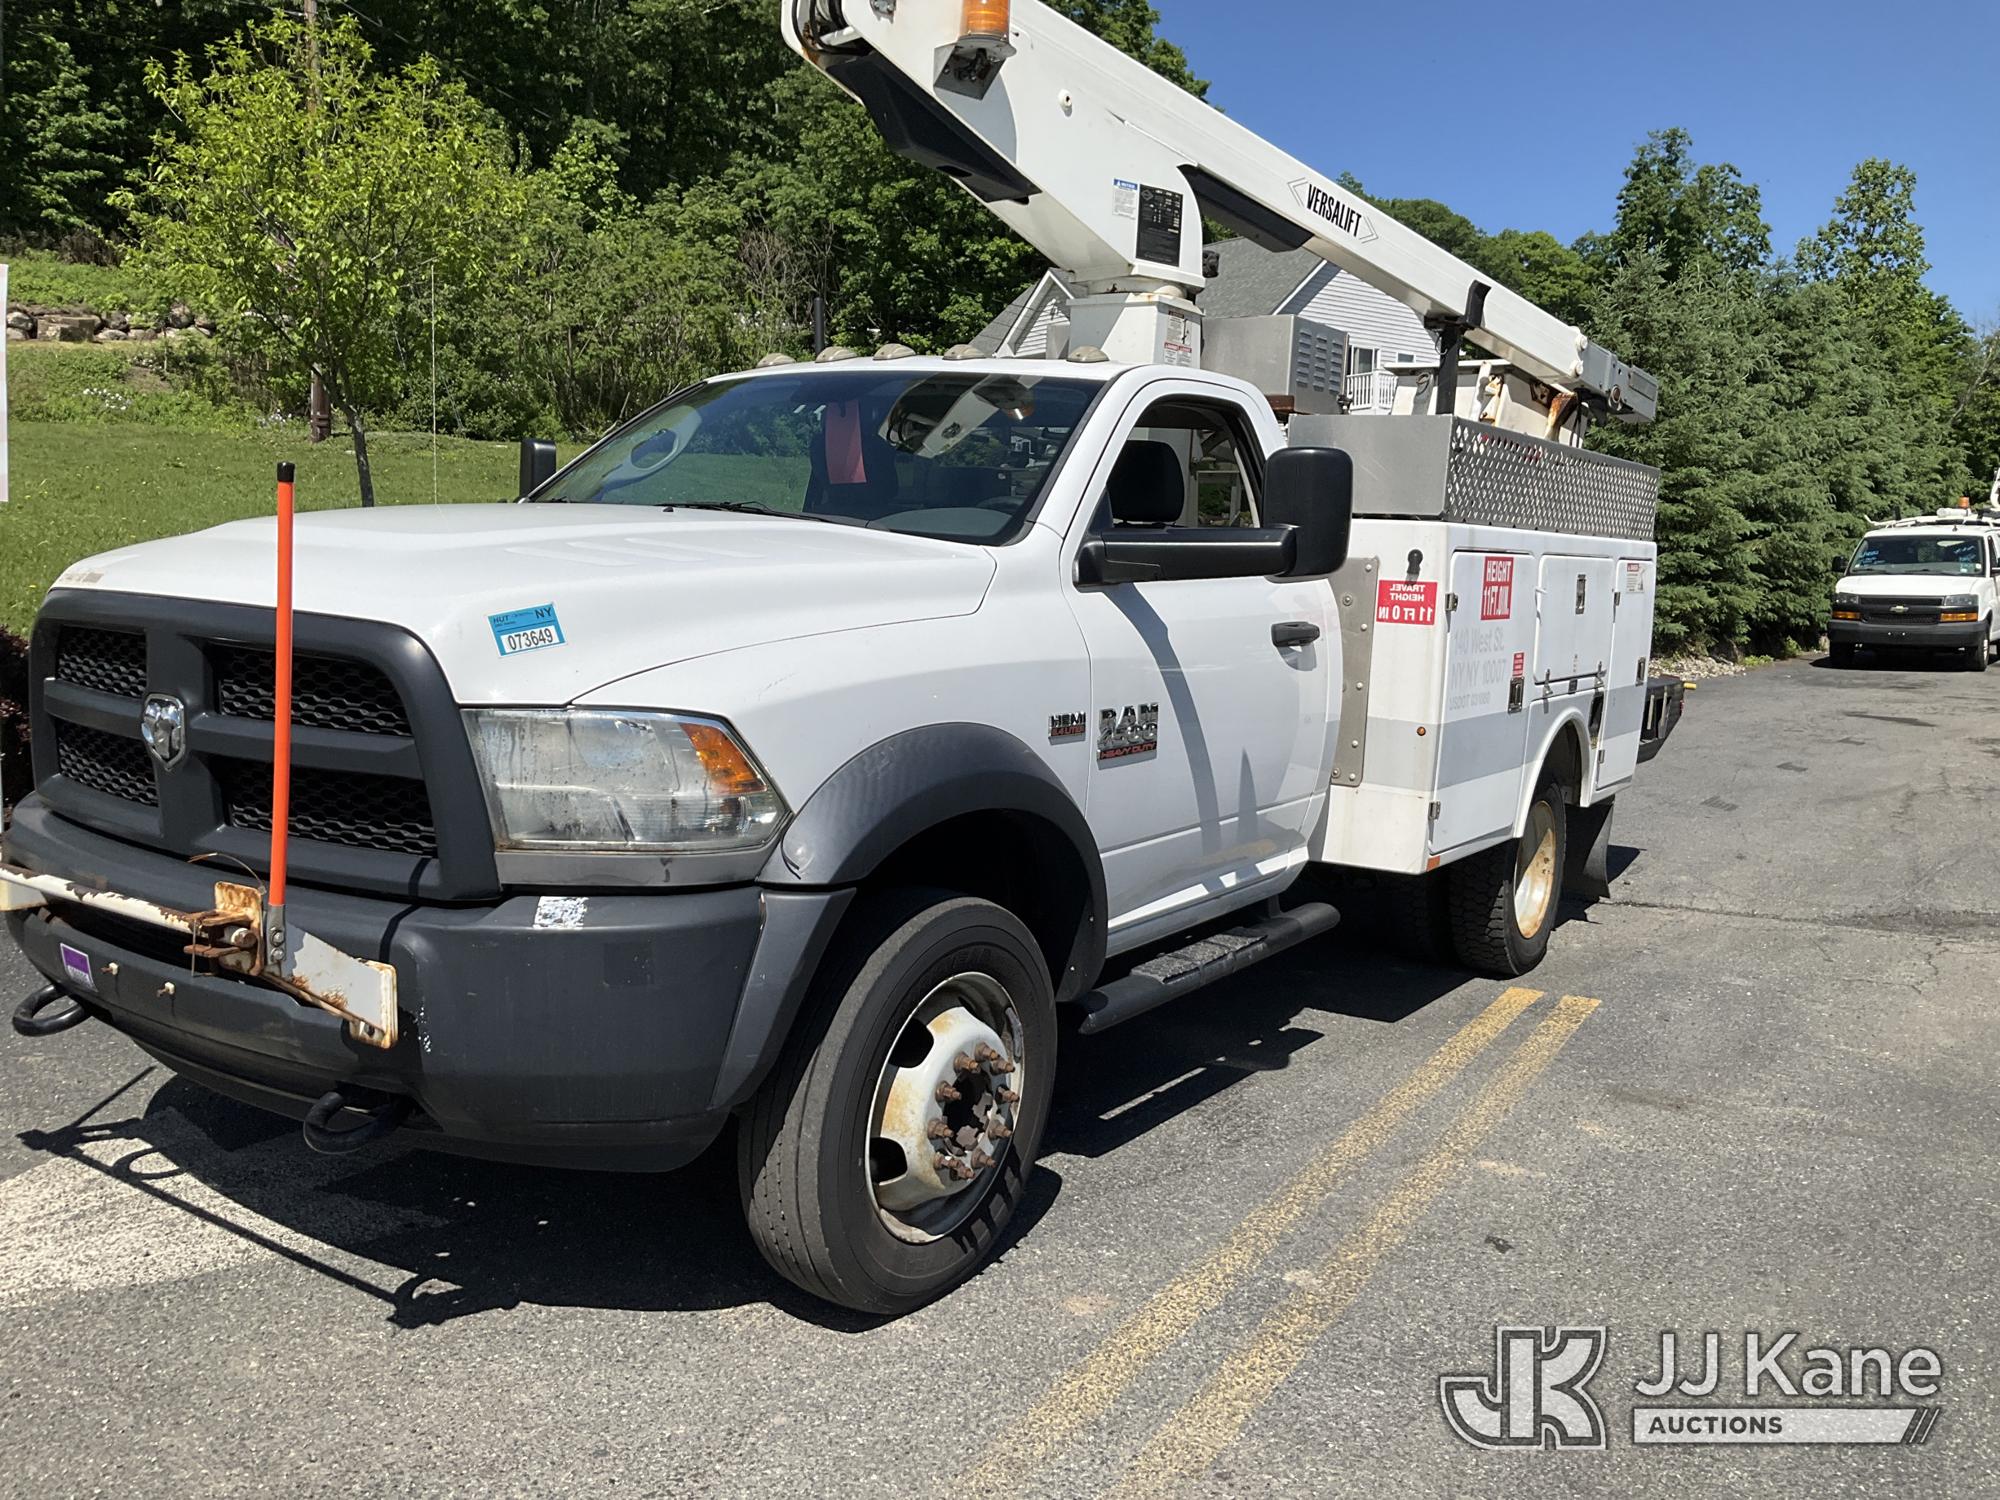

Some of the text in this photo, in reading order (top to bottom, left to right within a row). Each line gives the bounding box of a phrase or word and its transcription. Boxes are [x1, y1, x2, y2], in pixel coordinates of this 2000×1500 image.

[1307, 183, 1362, 237] VERSALIFT
[1487, 560, 1512, 582] HEIGHT
[534, 607, 552, 619] NY
[507, 627, 553, 650] 073649
[1049, 711, 1086, 729] HEMI
[1099, 702, 1159, 728] RAM
[1101, 742, 1156, 759] HEAVY DUTY
